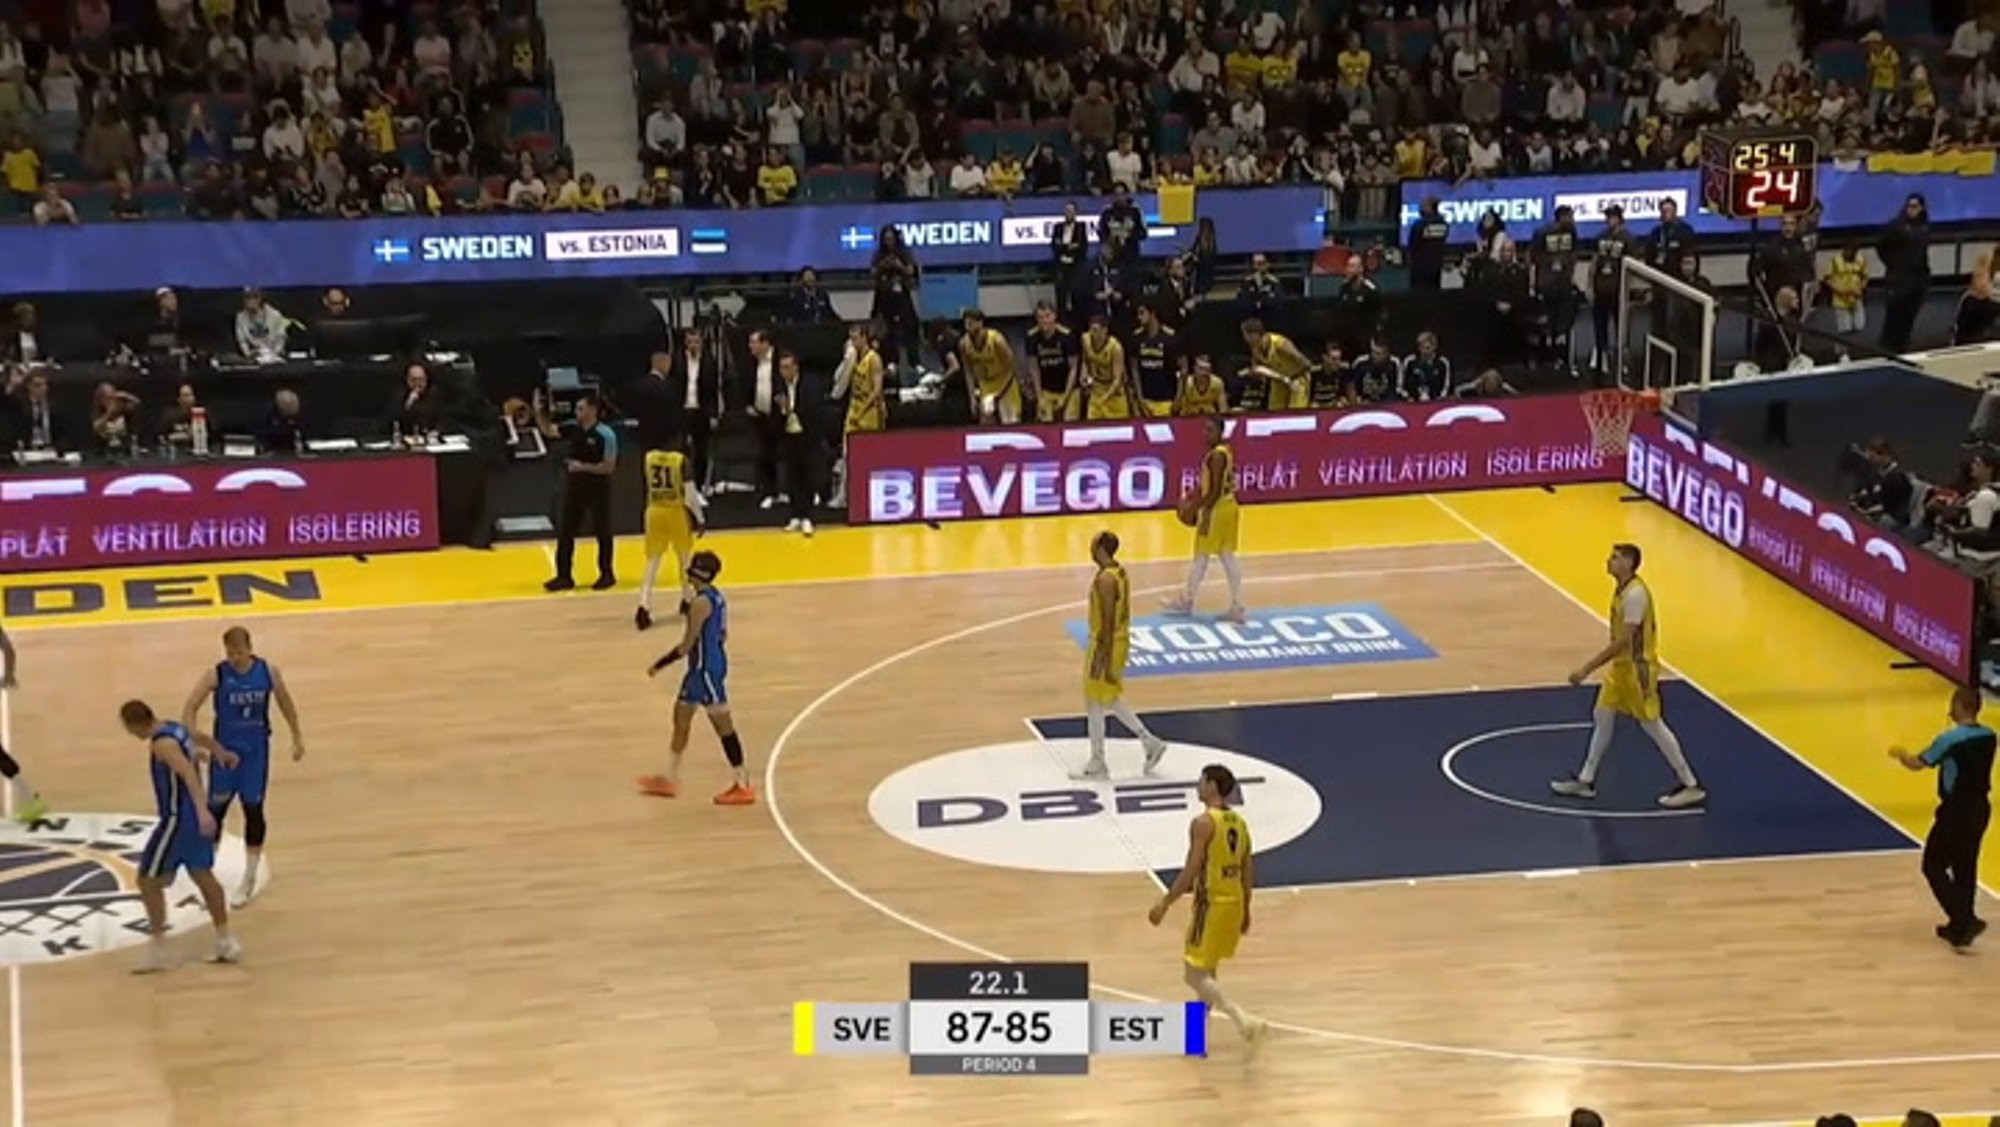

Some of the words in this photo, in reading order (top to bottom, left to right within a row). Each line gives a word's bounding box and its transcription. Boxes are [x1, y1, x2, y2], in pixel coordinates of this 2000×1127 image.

[1745, 170, 1799, 208] 24
[422, 234, 533, 261] SWEDEN
[558, 241, 583, 254] vs.
[589, 233, 667, 253] ESTONIA
[894, 220, 991, 246] WEDEN
[1015, 227, 1038, 239] vs.
[650, 465, 674, 489] 31
[1318, 450, 1468, 487] VENTILATION
[1486, 443, 1604, 476] ISOLERING
[868, 458, 1165, 522] BEVEGO
[1626, 434, 1745, 549] BEVEGO
[91, 514, 266, 553] VENTILATION
[288, 509, 421, 544] ISOLERING
[4, 569, 322, 618] DEN
[1128, 611, 1392, 653] NOCCO
[1165, 642, 1330, 664] PERFORMANCE
[1332, 637, 1408, 655] DRINK
[917, 776, 1266, 829] DBET
